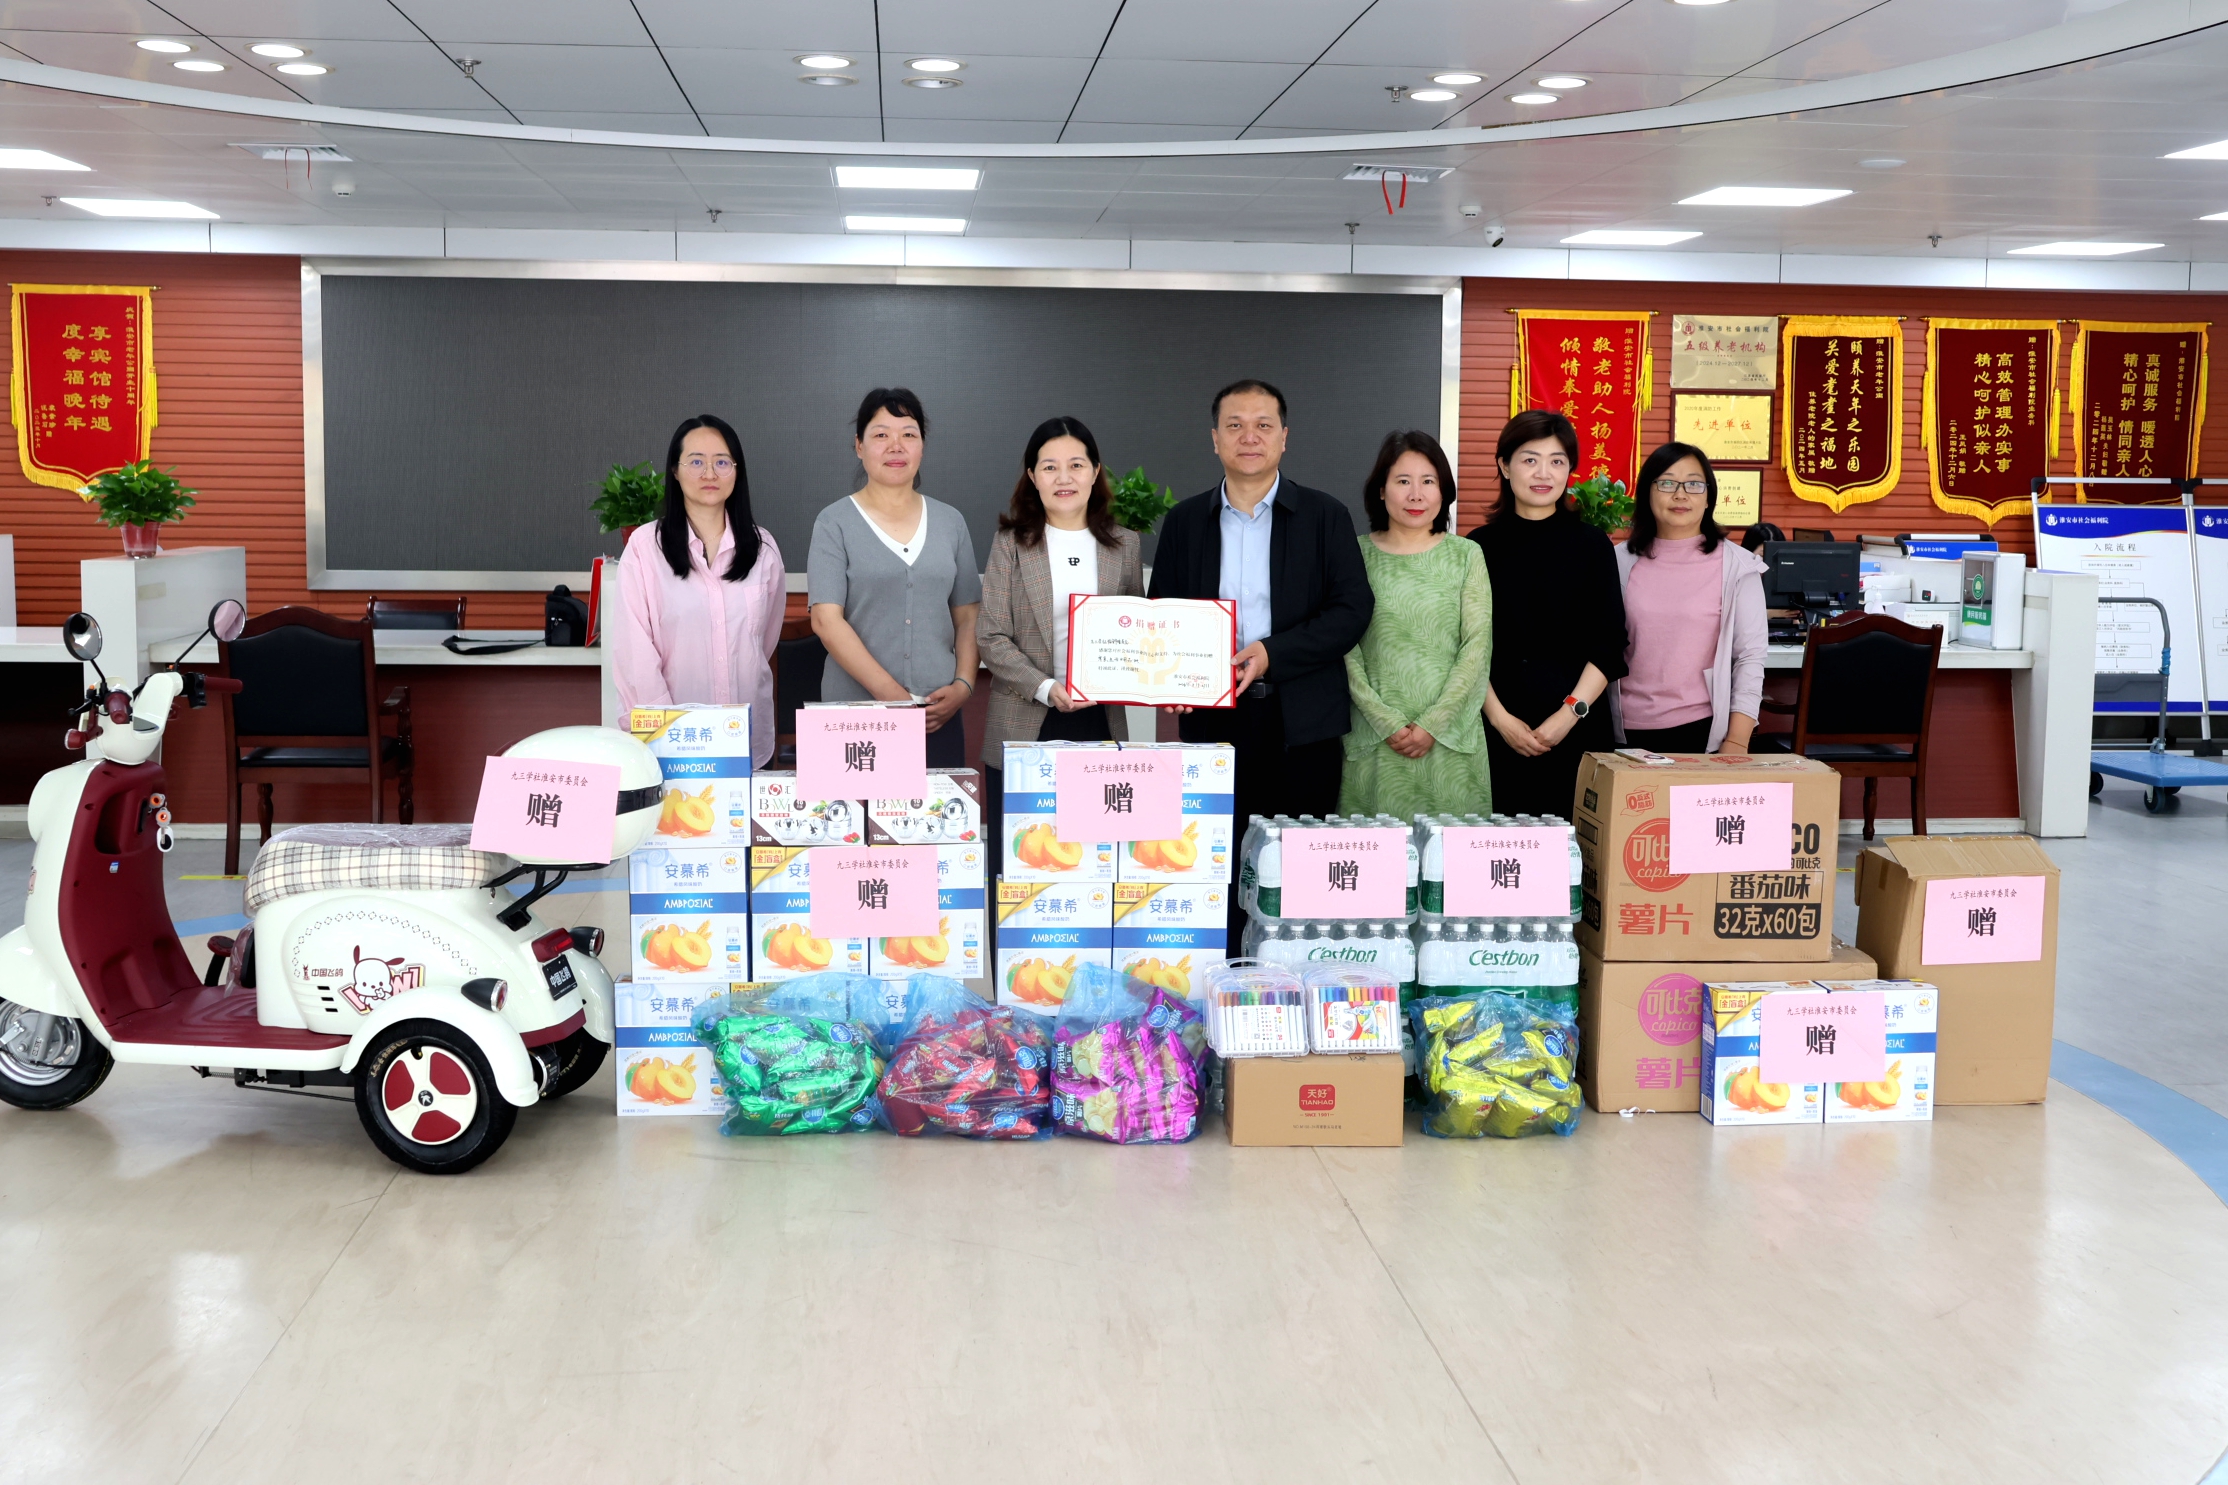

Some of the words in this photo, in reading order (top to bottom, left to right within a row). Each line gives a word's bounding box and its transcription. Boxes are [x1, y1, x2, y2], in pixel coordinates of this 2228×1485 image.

[1684, 340, 1766, 353] 五级养老机构
[62, 324, 86, 430] 度幸福晚年
[89, 326, 112, 431] 享宾馆待遇
[2120, 352, 2139, 411] 精心呵护
[2143, 354, 2160, 412] 真诚服务
[1820, 339, 1839, 470] 关爱耄耋之福地
[1847, 340, 1864, 472] 颐养天年之乐园
[1973, 352, 1992, 473] 精心呵护似亲人
[1995, 352, 2014, 472] 高效管理办实事
[1693, 418, 1751, 431] 先进单位
[1948, 420, 1958, 486] 二零二四年十二月六日
[2115, 420, 2134, 477] 情同亲人
[2138, 420, 2156, 478] 暖透人心
[1720, 494, 1746, 506] 单位
[2094, 542, 2137, 552] 入院流程
[1136, 618, 1180, 630] 捐赠证书
[668, 727, 712, 742] 安慕希
[824, 722, 898, 732] 九三学社淮安市委员会
[846, 741, 876, 772] 赠
[1083, 762, 1155, 774] 九三学社淮安市委员会
[510, 772, 589, 786] 九三学社淮安市委员会
[526, 793, 562, 827] 赠
[760, 798, 793, 812] BOWL
[876, 798, 908, 812] BOWL
[1105, 782, 1133, 813] 赠
[1696, 796, 1766, 808] 九三学社淮安市委员会
[1716, 815, 1745, 845] 赠
[1791, 822, 1820, 854] CO
[1308, 840, 1380, 852] 九三学社淮安市委员会
[1469, 840, 1541, 850] 九三学社淮安市委员会
[1632, 834, 1669, 868] 可比
[666, 863, 710, 878] 安慕希
[836, 858, 910, 870] 九三学社淮安市委员会
[1329, 860, 1358, 891] 赠
[1491, 858, 1520, 889] 赠
[858, 879, 888, 909] 赠
[1730, 873, 1810, 900] 番茄味
[1950, 888, 2018, 900] 九三学社淮安市委员会
[1034, 899, 1077, 914] 安慕希
[1150, 899, 1192, 914] 安慕希
[1619, 903, 1694, 936] 薯片
[1968, 907, 1996, 936] 赠
[312, 968, 344, 977] 中国飞鸽
[550, 966, 571, 988] 中国飞鸽
[650, 997, 694, 1012] 安慕希
[1647, 988, 1702, 1020] 可比克
[1787, 1004, 1857, 1016] 九三学社淮安市委员会
[1651, 1018, 1697, 1035] copico
[1807, 1025, 1836, 1054] 赠
[1635, 1057, 1700, 1089] 薯片
[1307, 1089, 1327, 1098] 天好
[1065, 1094, 1076, 1126] 原滋味
